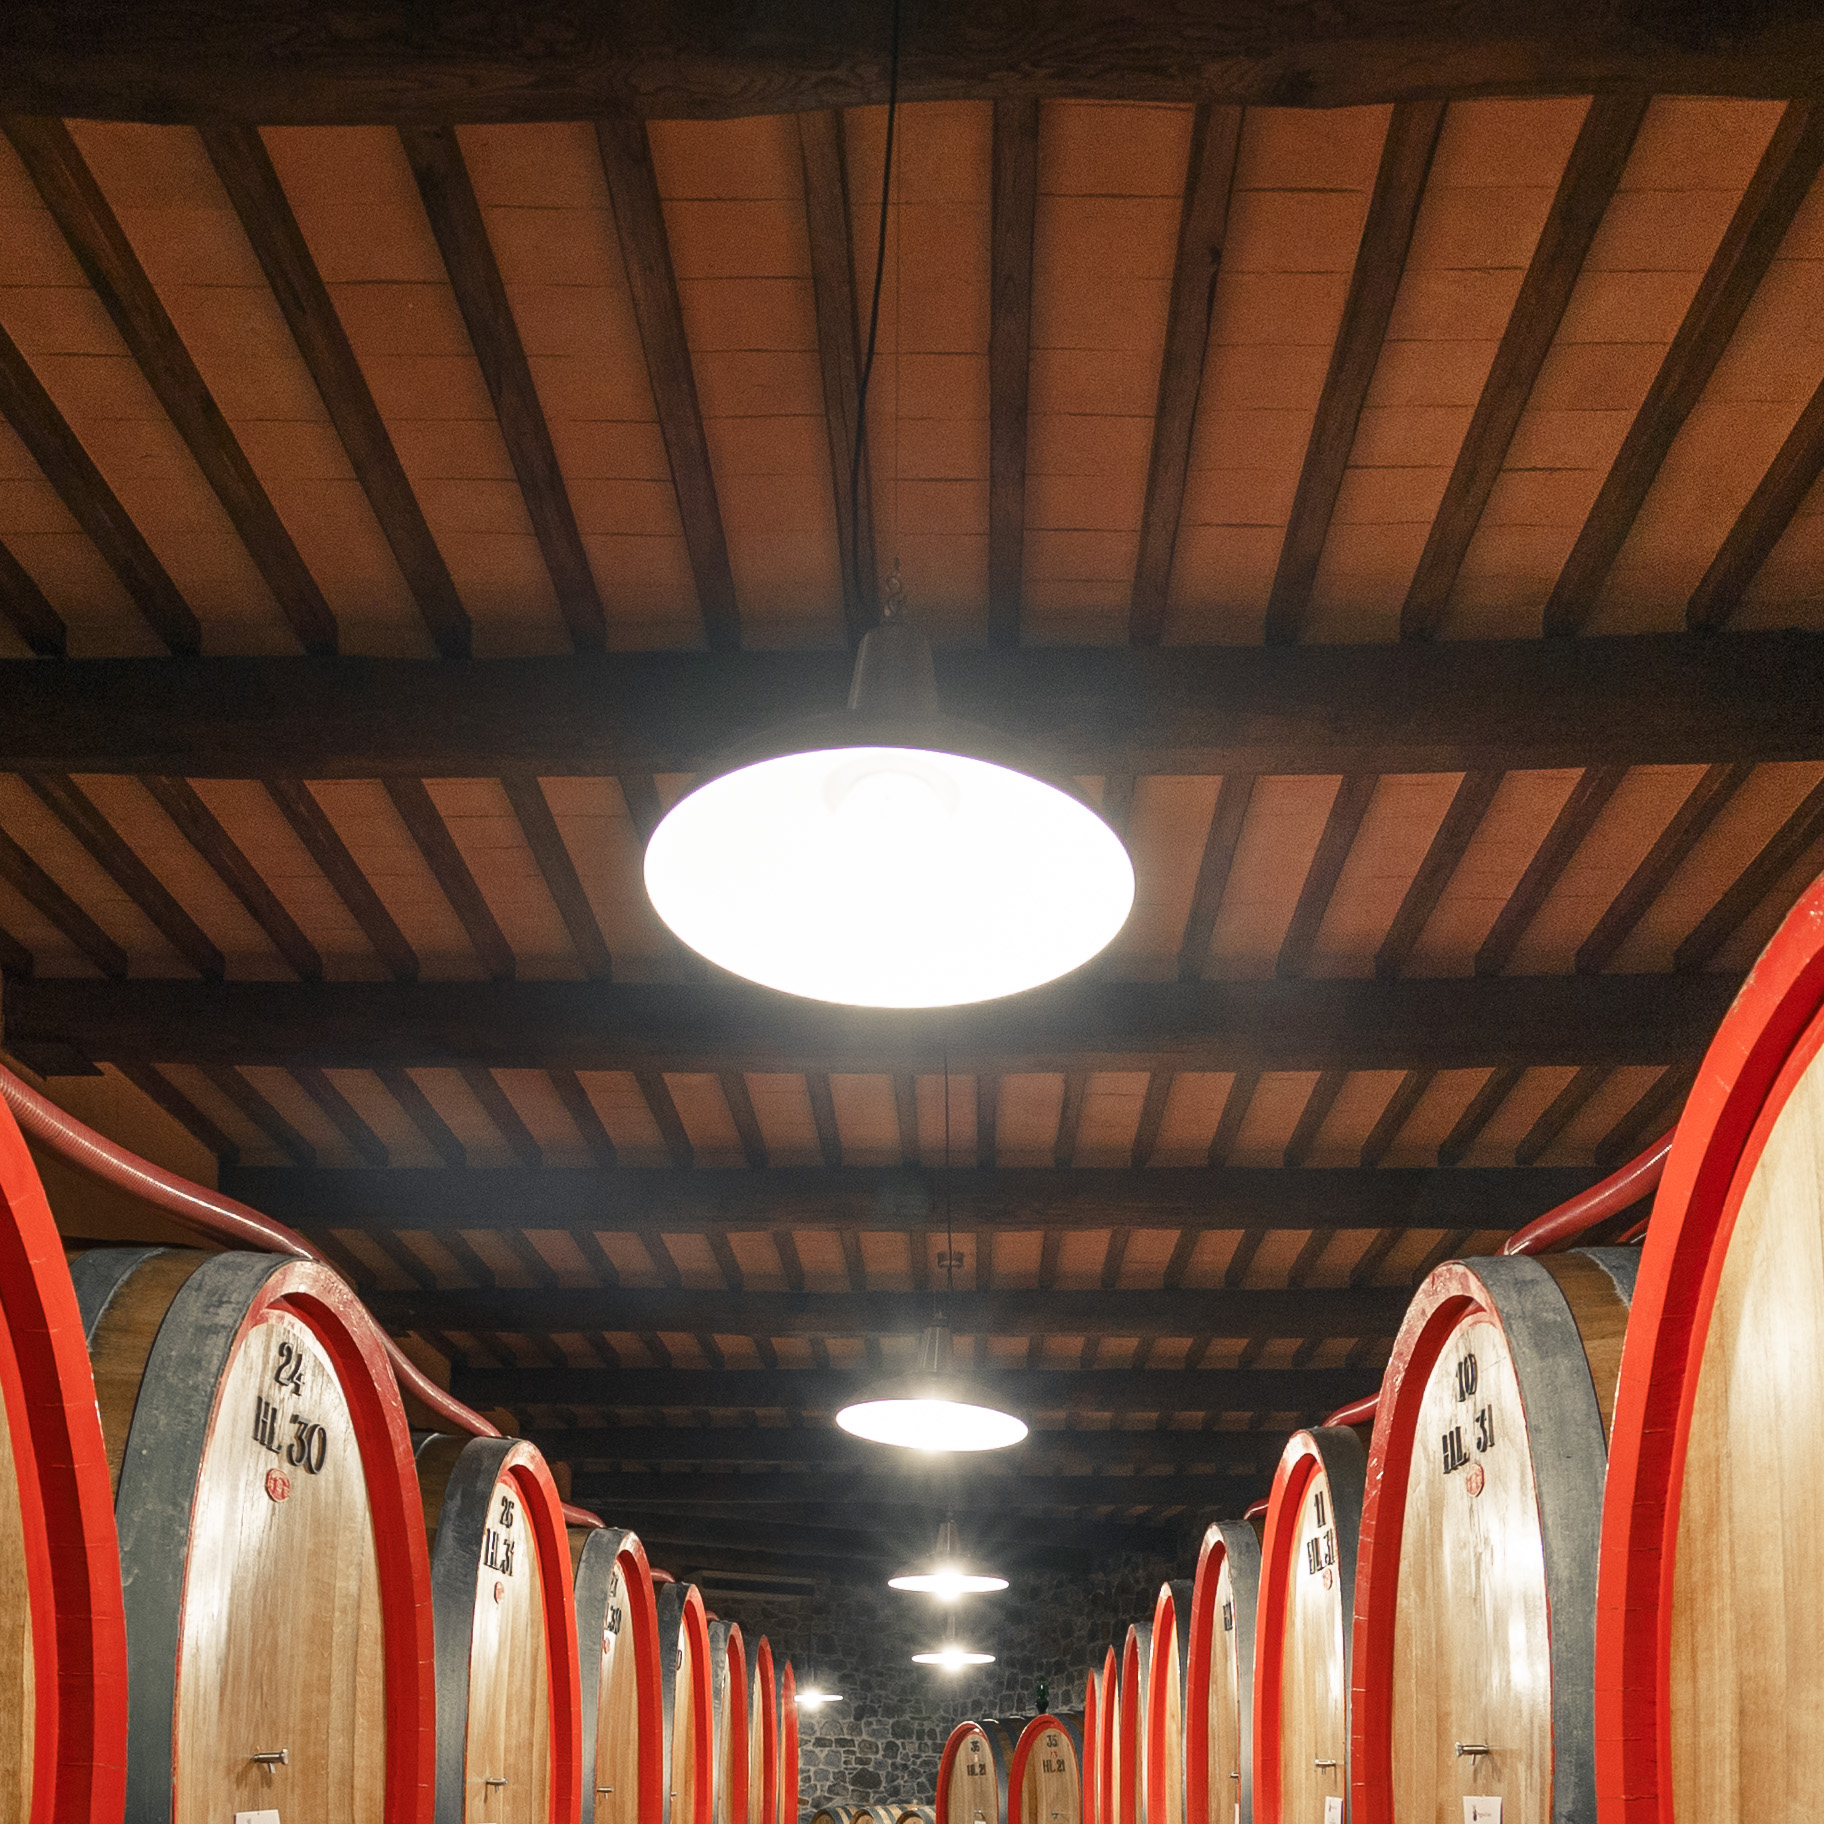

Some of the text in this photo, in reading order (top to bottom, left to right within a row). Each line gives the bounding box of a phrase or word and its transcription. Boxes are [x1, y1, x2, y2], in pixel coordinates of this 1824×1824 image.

[274, 1341, 306, 1397] 24
[1456, 1353, 1478, 1403] 10
[251, 1395, 327, 1475] HL 30
[1442, 1403, 1496, 1475] HL 31
[1314, 1490, 1326, 1529] 11
